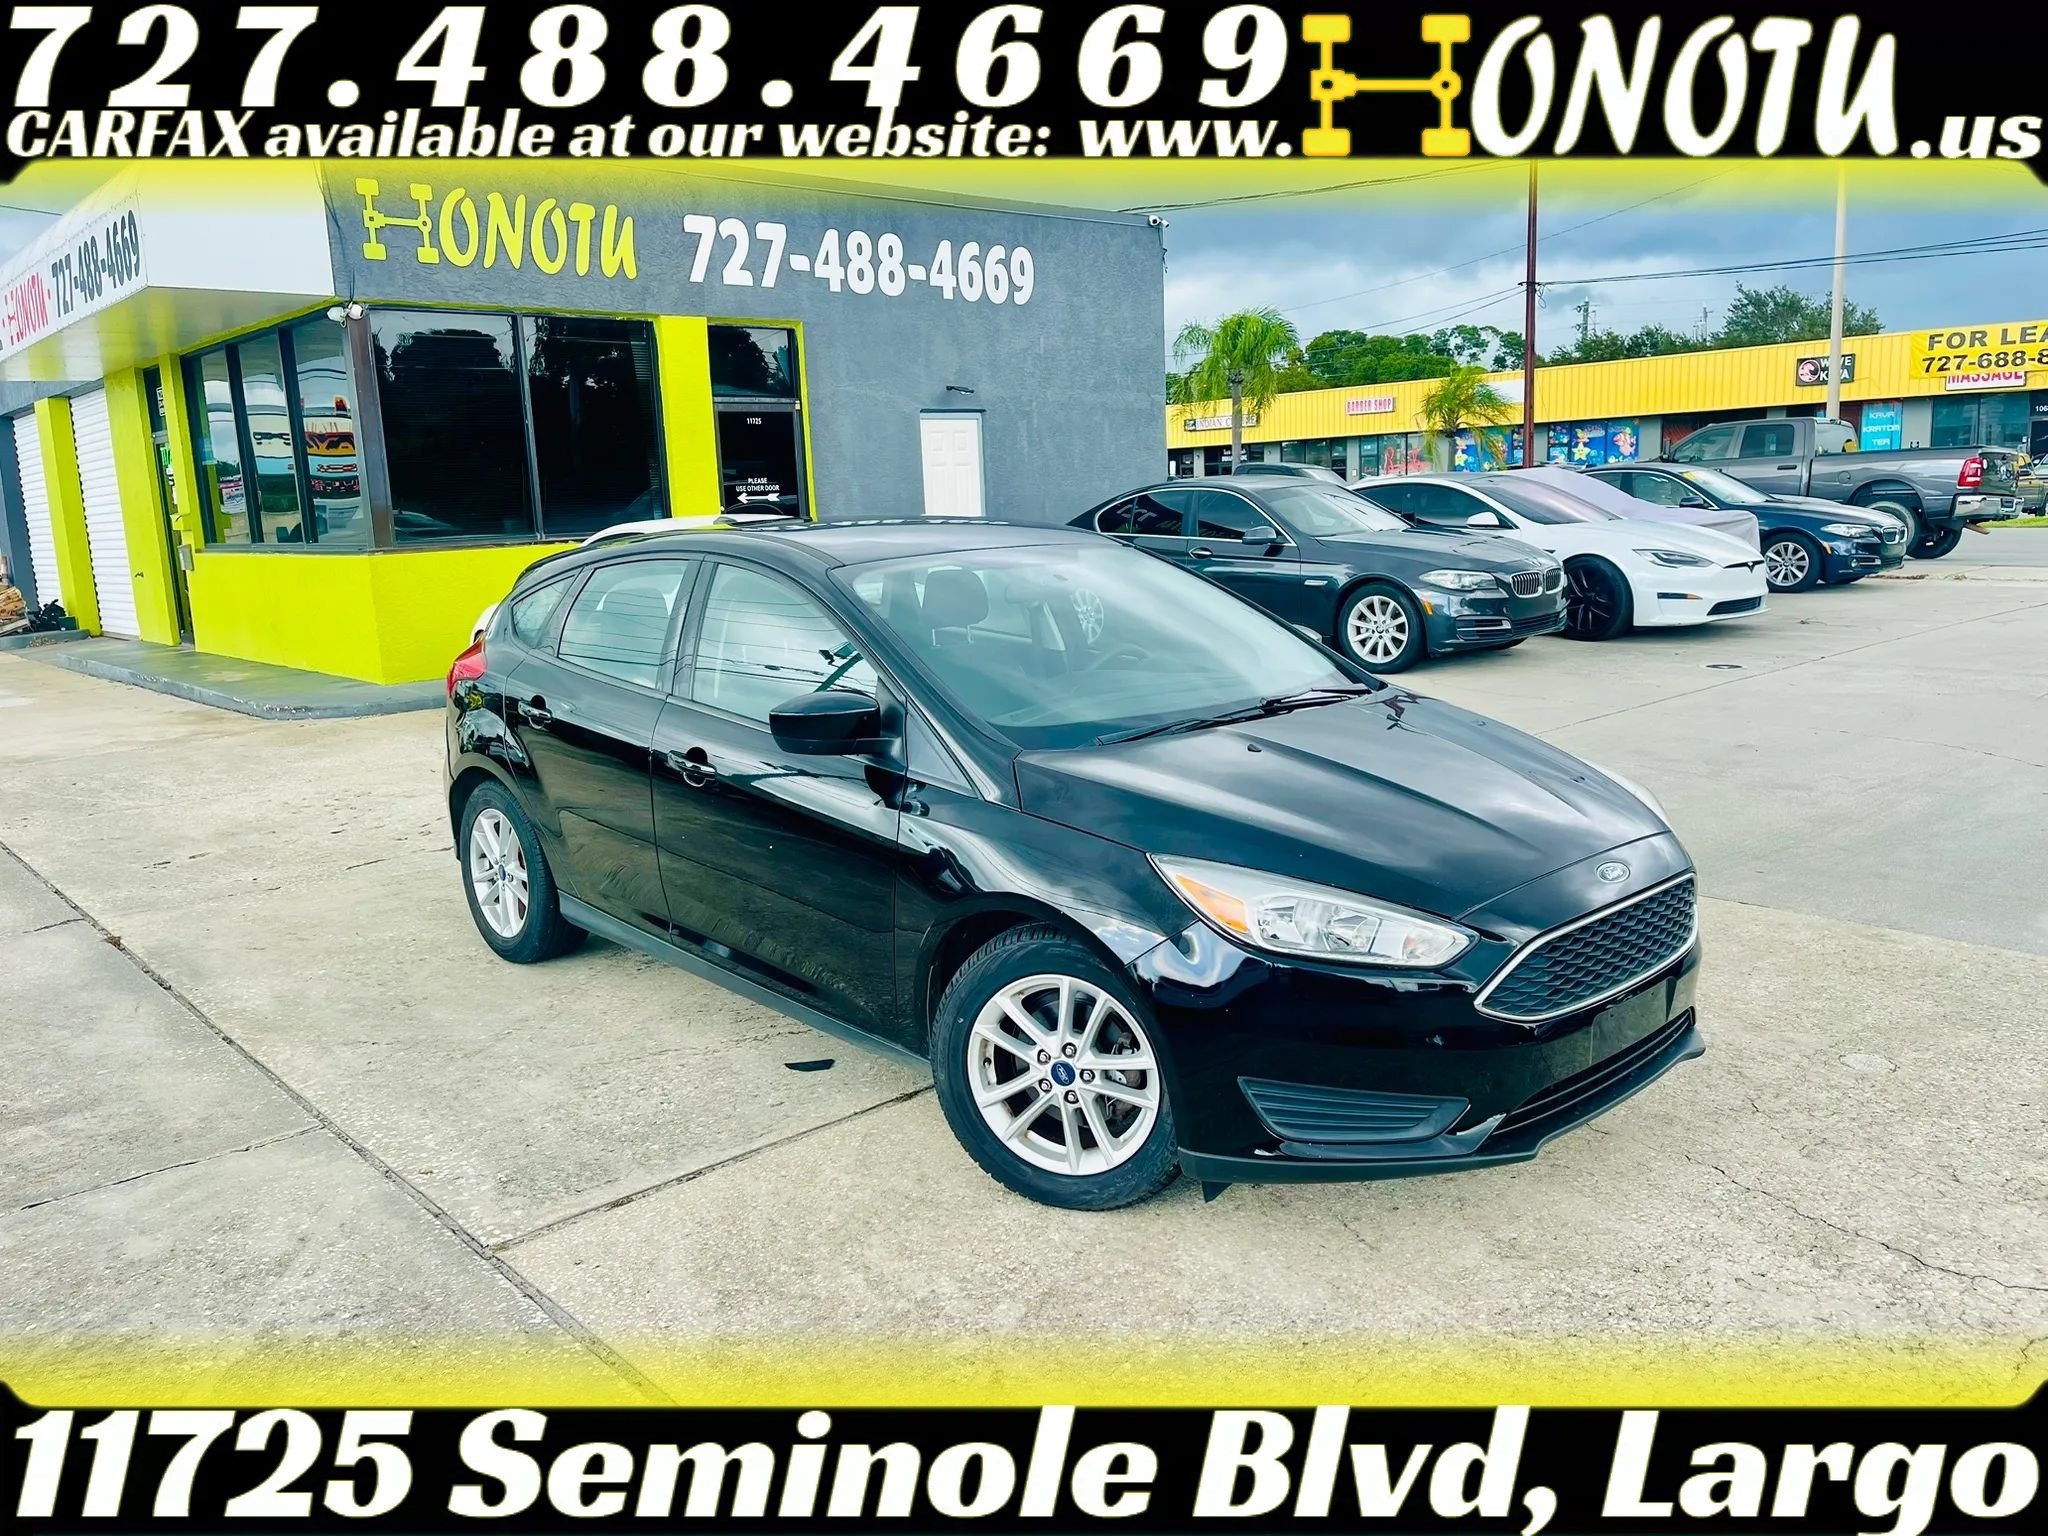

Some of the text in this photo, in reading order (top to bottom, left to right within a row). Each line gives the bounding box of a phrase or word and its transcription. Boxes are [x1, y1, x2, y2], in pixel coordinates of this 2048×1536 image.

[51, 209, 141, 319] 727-488-4669
[683, 214, 1035, 306] 727-488-4669
[1928, 330, 1988, 352] FOR
[1820, 356, 1852, 368] WVE
[1922, 349, 2048, 374] 727-688-8
[1820, 370, 1850, 381] KA
[1374, 398, 1392, 411] SHOP
[747, 477, 768, 485] PLEASE
